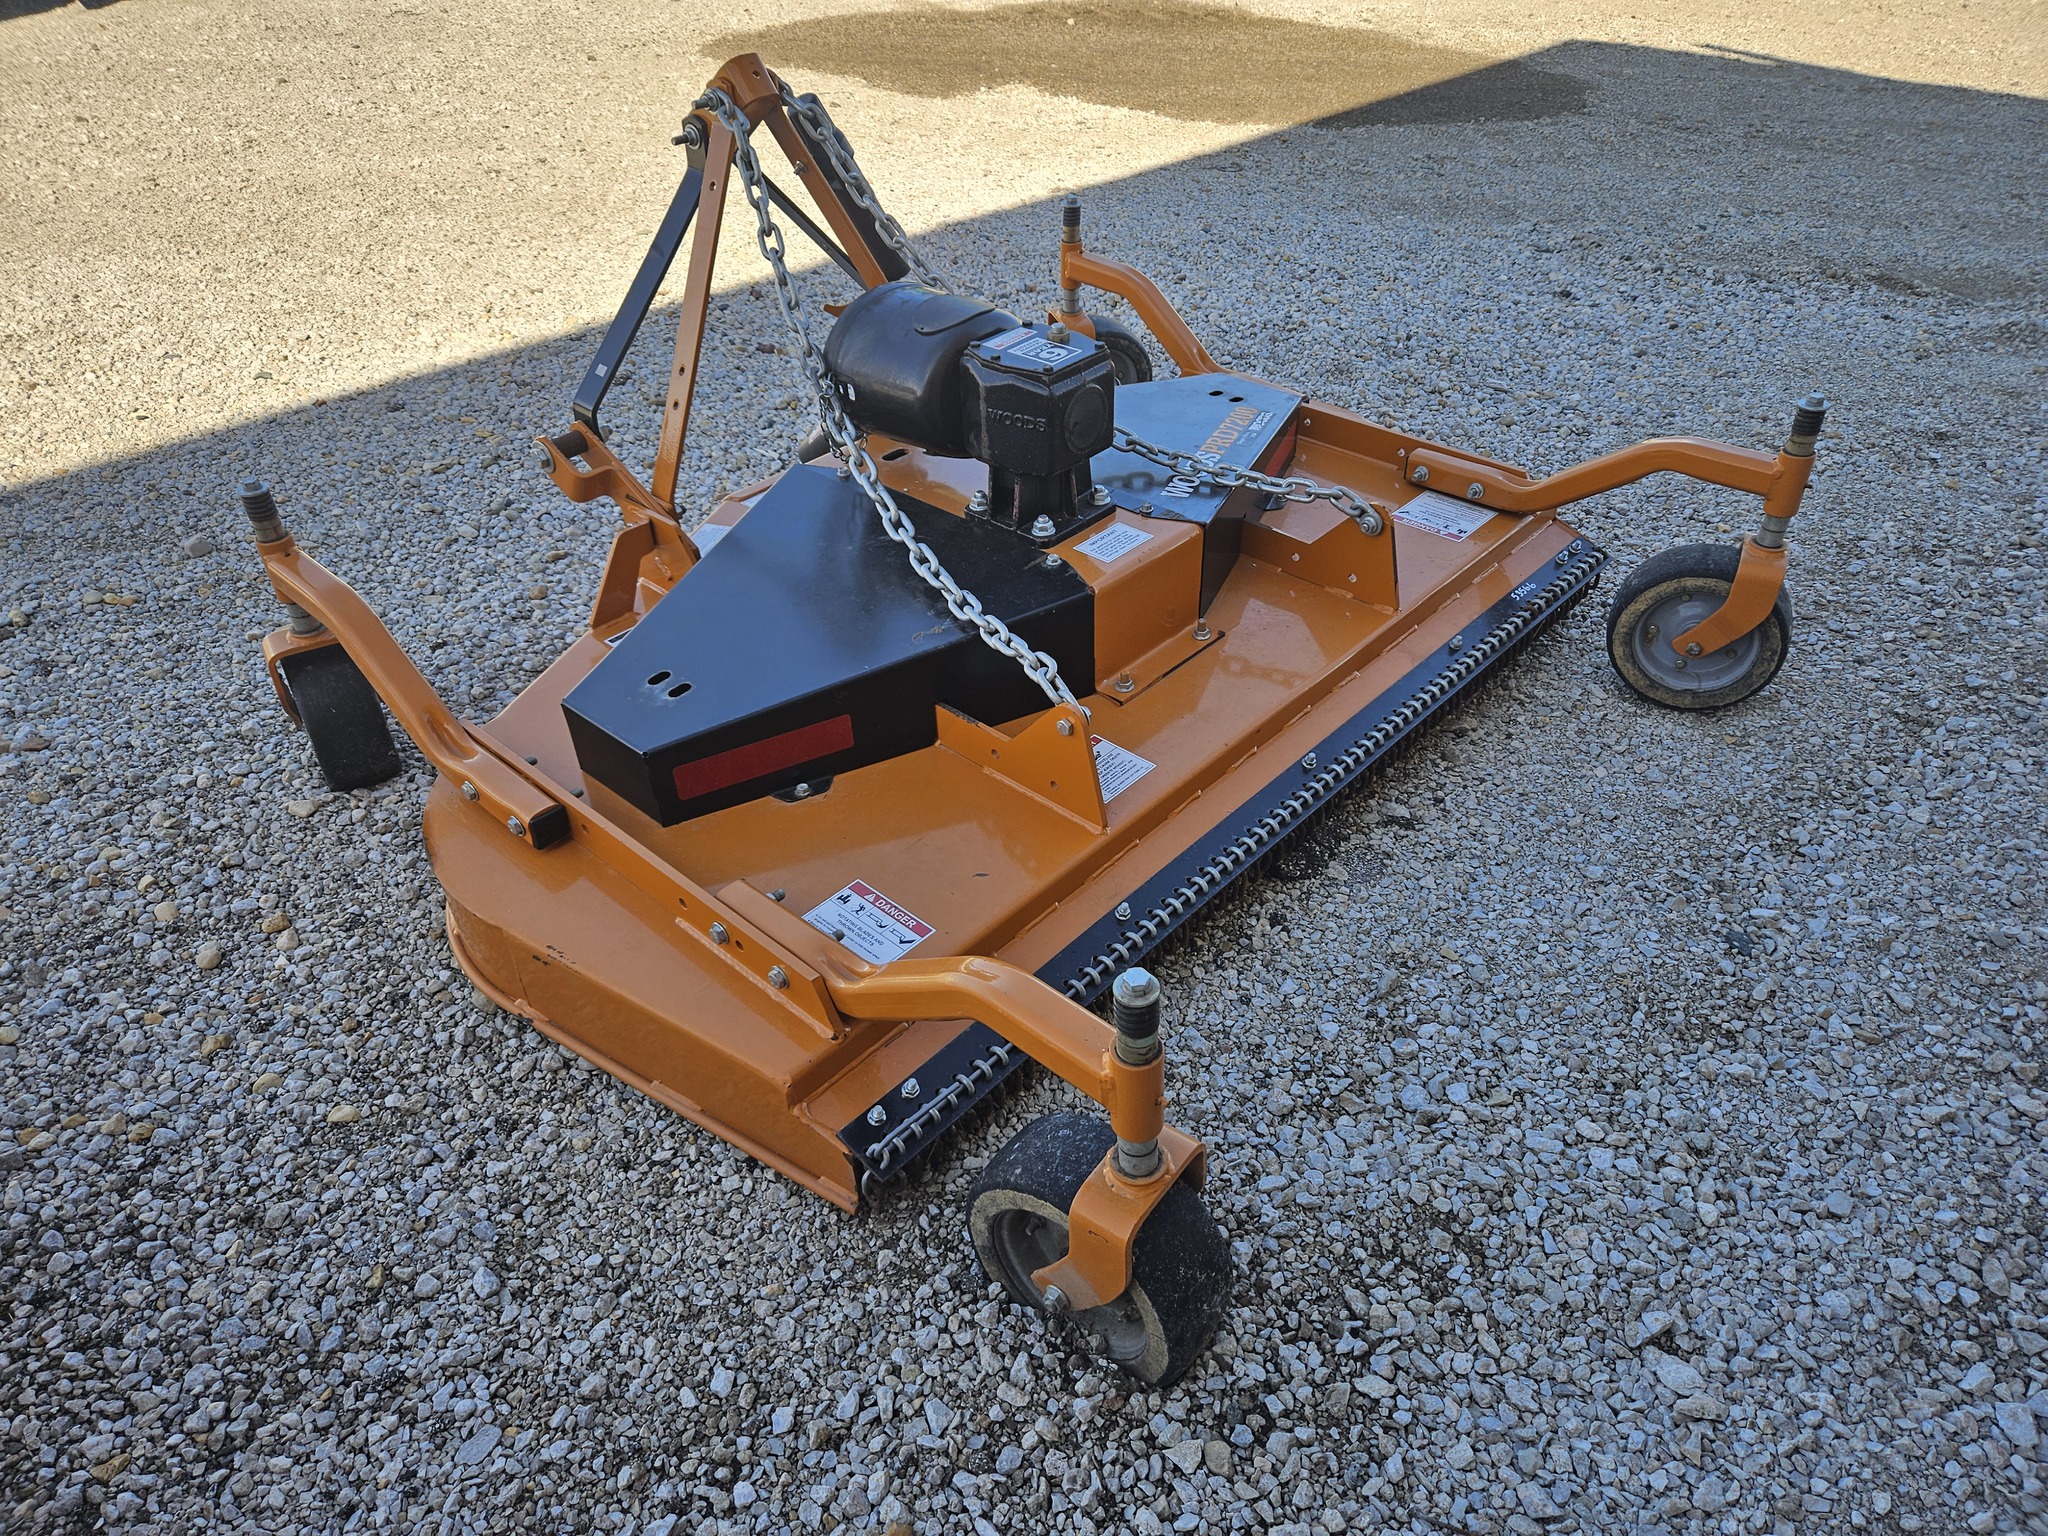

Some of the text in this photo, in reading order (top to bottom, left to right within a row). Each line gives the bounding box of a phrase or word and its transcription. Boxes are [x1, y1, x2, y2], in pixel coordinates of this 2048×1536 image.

[1038, 348, 1069, 360] 6
[987, 408, 1047, 432] WOODS
[1160, 451, 1222, 498] WOS
[1200, 406, 1259, 455] PRD7200
[1402, 518, 1438, 533] DANGER
[837, 912, 859, 929] ROTATING
[875, 899, 917, 929] DANGER
